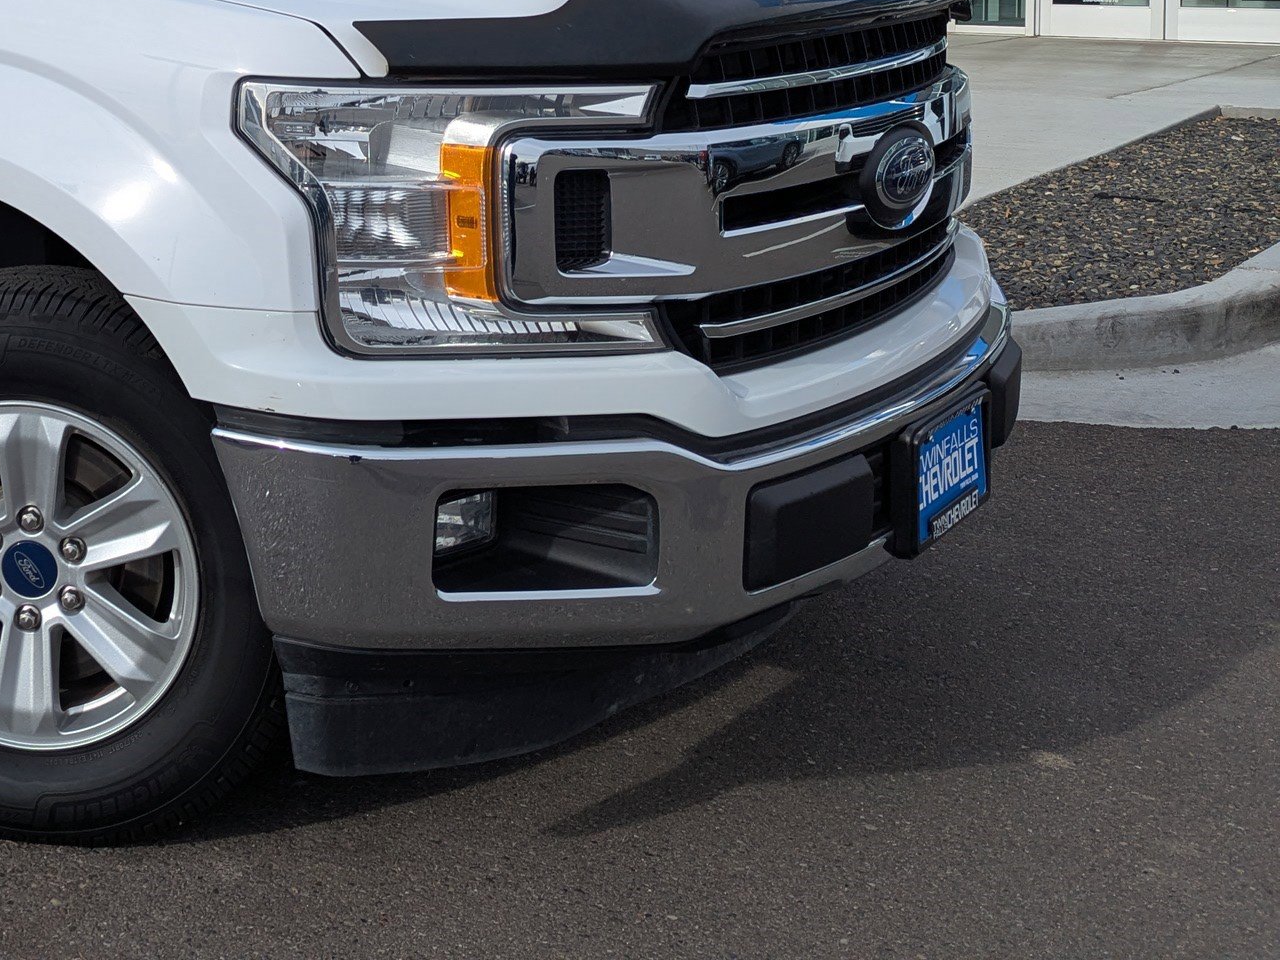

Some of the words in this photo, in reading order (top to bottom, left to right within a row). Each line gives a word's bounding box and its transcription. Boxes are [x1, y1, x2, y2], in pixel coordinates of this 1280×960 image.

[17, 337, 92, 361] DEFENDER
[919, 418, 979, 473] WINFALLS
[947, 490, 979, 529] CHEVROLET
